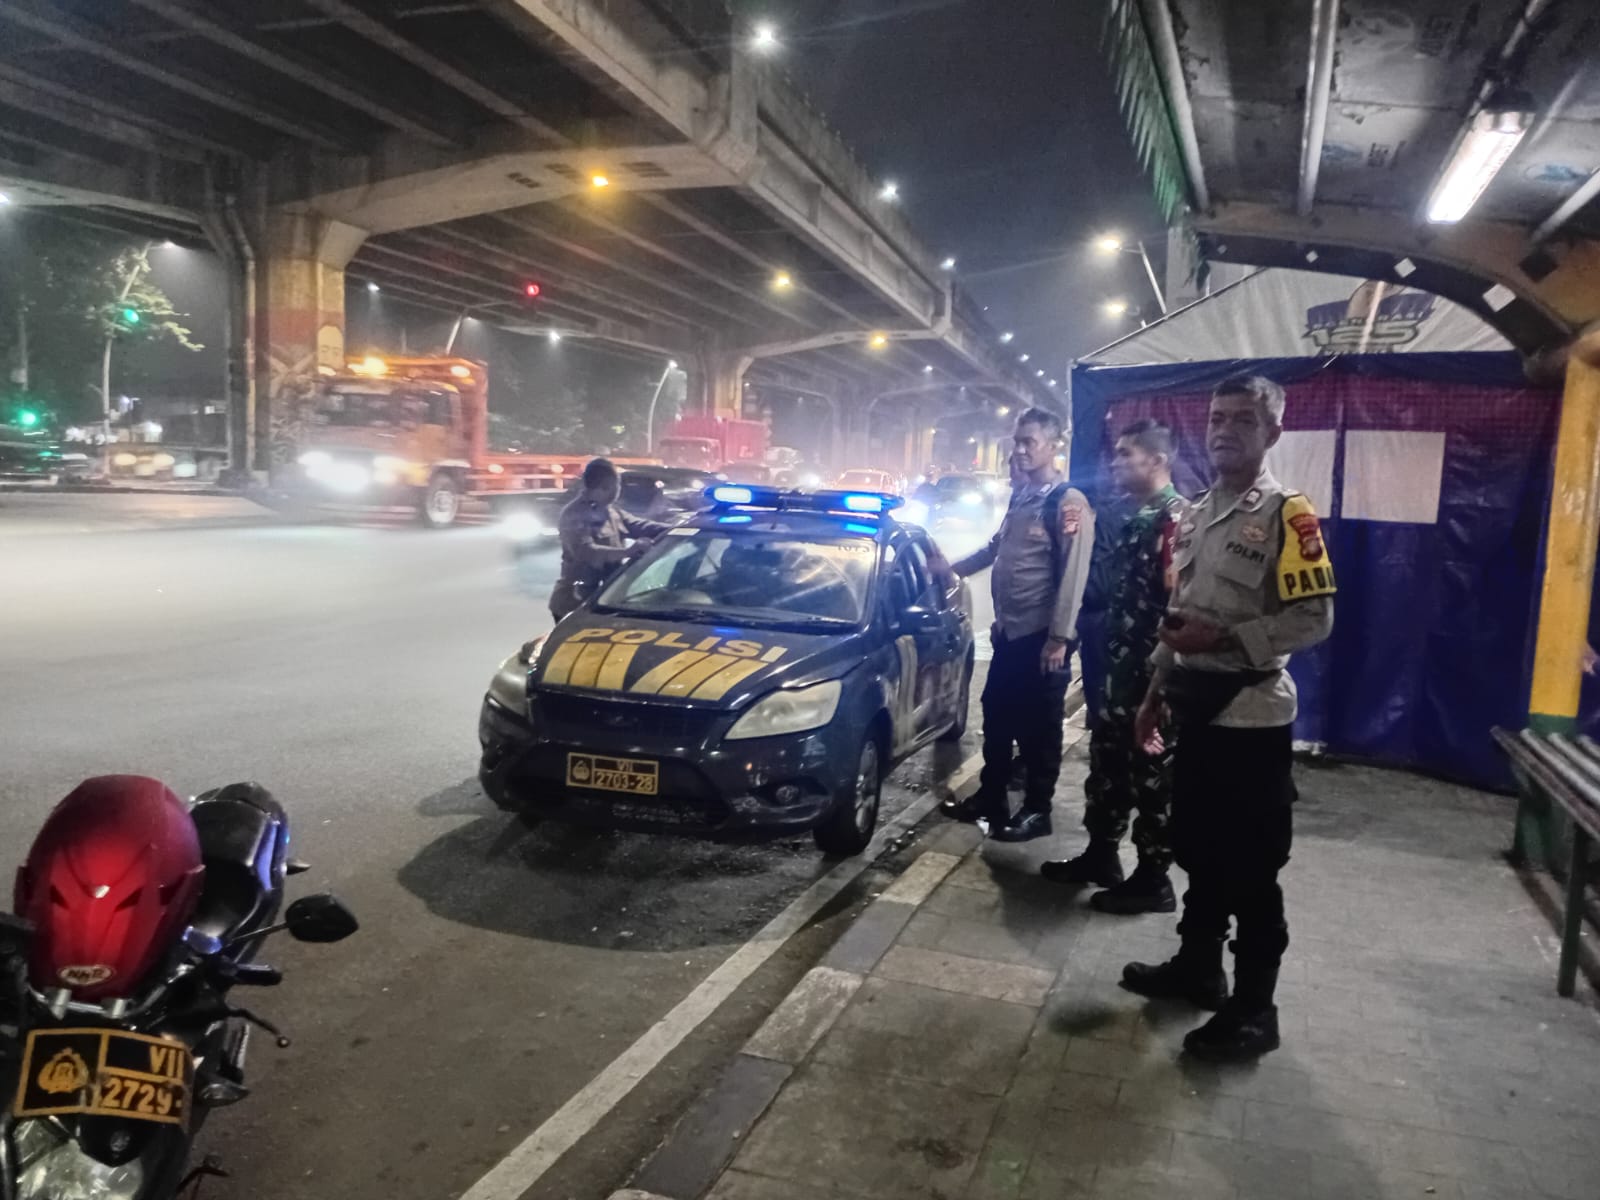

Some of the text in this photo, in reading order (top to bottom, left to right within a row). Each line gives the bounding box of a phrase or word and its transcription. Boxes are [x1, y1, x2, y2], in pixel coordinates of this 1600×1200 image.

[1226, 541, 1266, 564] POLRI
[565, 628, 788, 664] POLISI
[150, 1045, 184, 1079] VII
